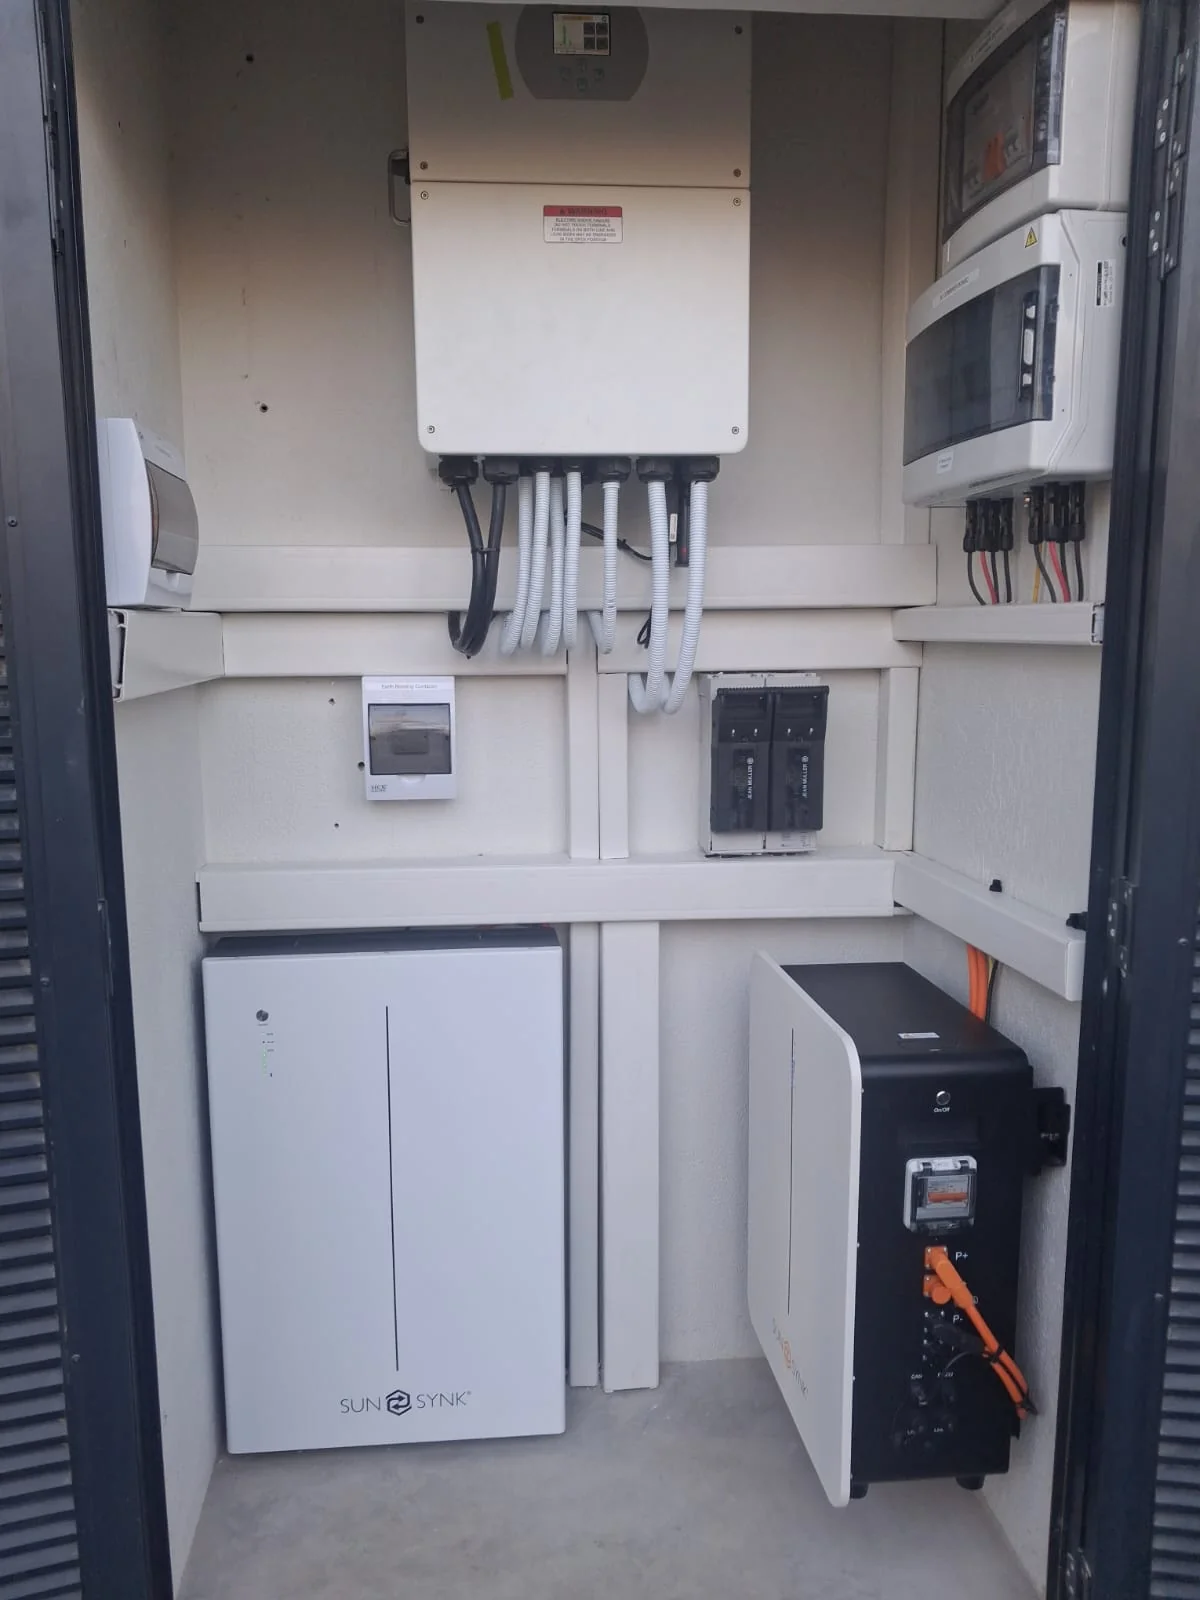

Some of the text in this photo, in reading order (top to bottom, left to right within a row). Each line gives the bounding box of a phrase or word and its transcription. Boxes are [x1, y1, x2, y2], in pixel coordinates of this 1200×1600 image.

[955, 1251, 969, 1261] P+
[952, 1314, 964, 1323] P-
[340, 1396, 381, 1414] SUN
